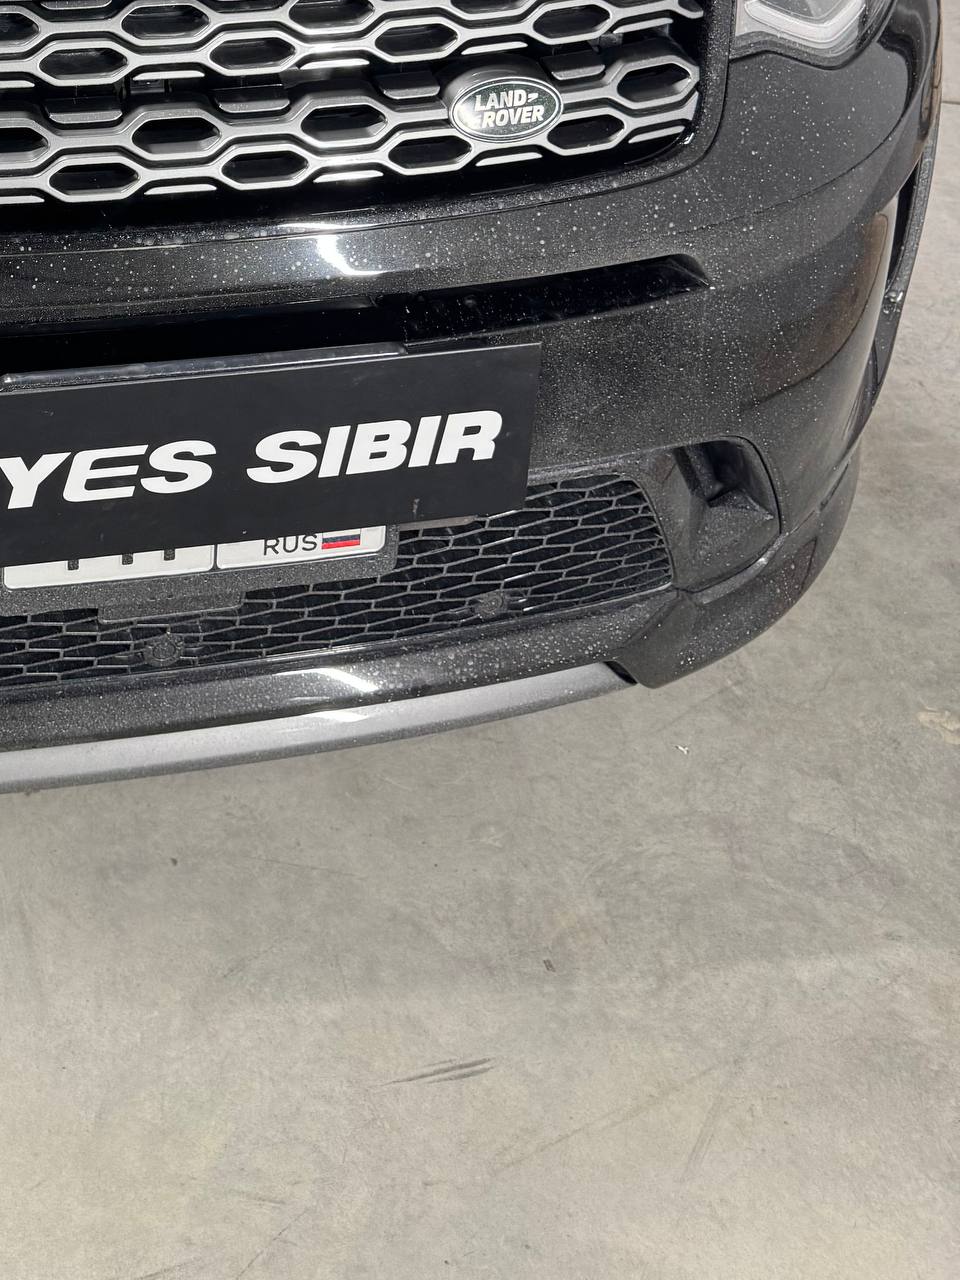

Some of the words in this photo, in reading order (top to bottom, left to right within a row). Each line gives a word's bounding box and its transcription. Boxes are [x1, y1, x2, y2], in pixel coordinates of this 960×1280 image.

[481, 104, 545, 128] ROVER
[246, 410, 503, 484] SIBIR
[262, 532, 318, 556] RUS
